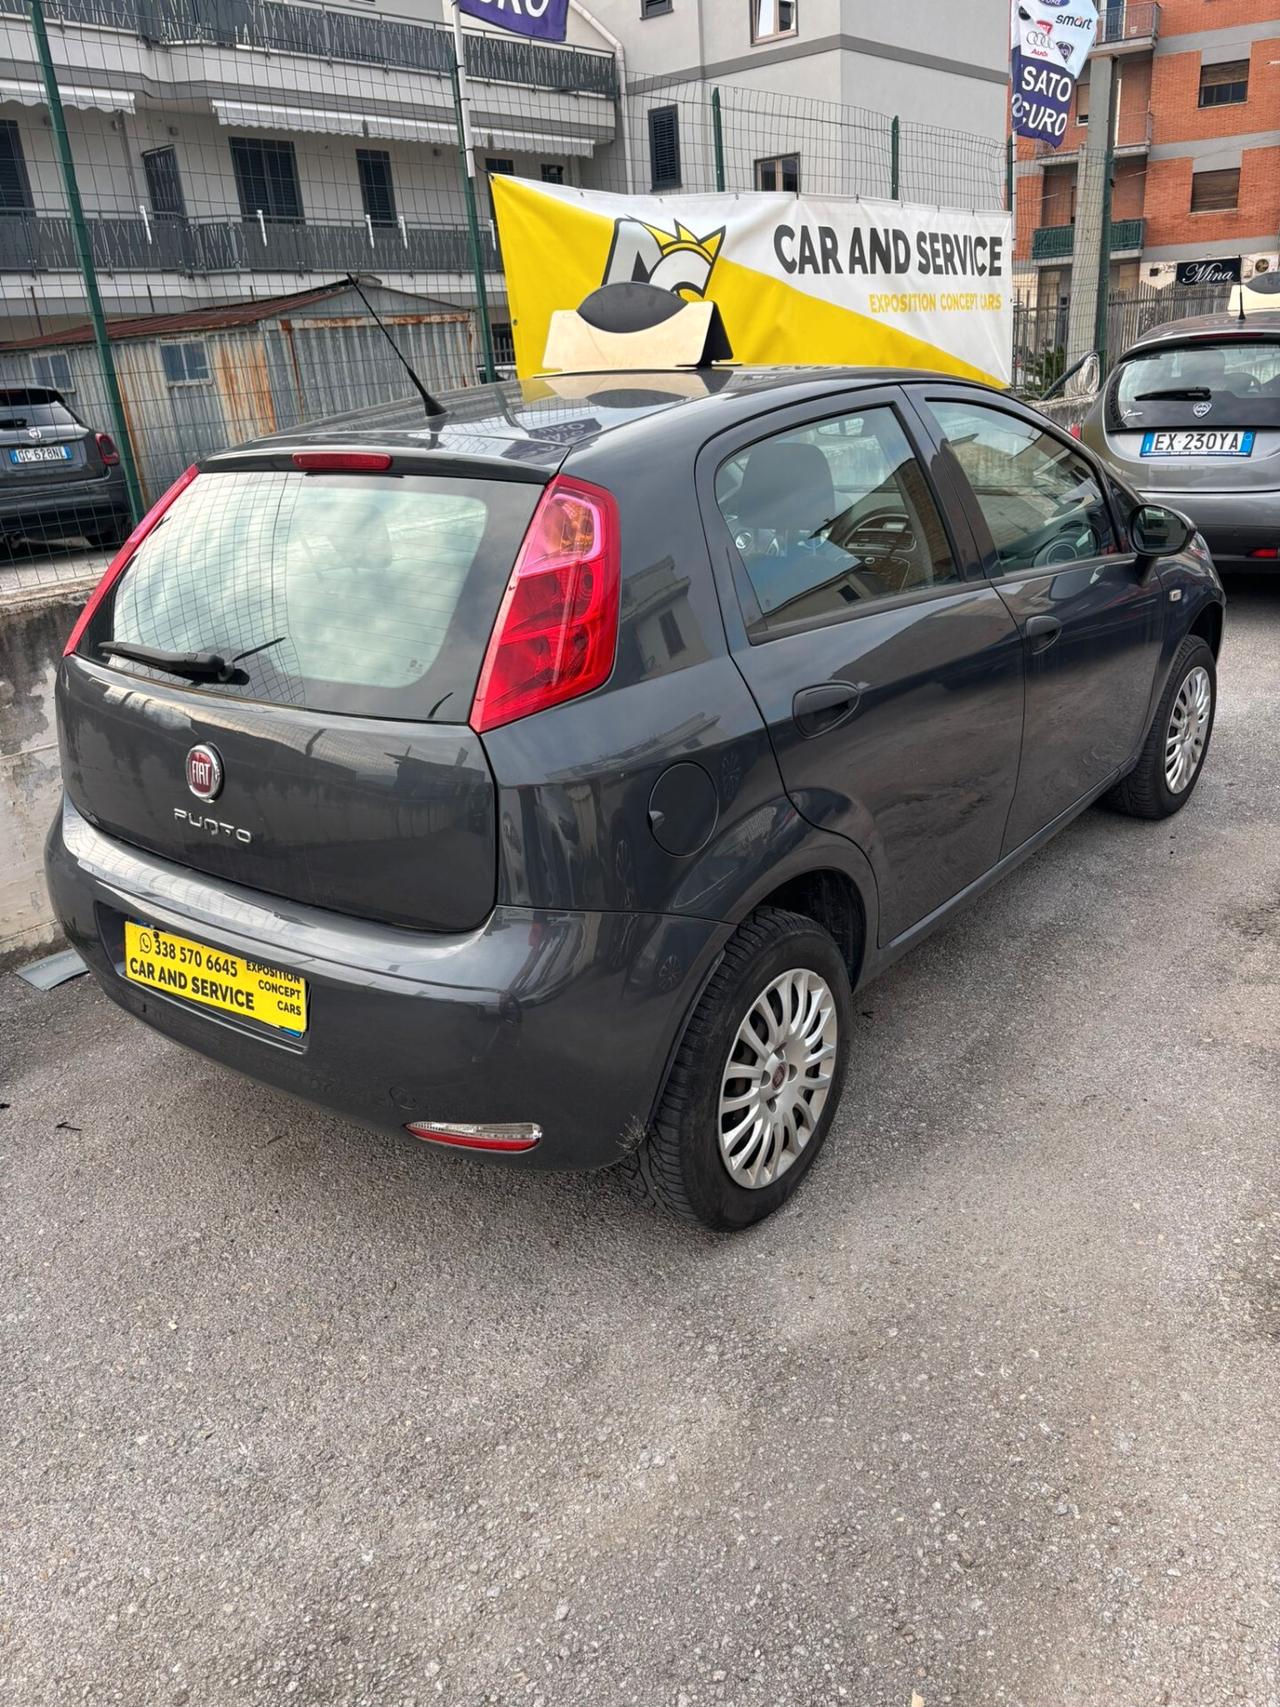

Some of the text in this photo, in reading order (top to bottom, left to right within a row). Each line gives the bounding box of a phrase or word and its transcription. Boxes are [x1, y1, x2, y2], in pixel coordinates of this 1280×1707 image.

[1055, 14, 1093, 30] smart
[773, 224, 844, 274] CAR
[849, 227, 911, 274] AND
[916, 230, 1003, 277] SERVICE
[1182, 262, 1234, 284] Mina
[868, 293, 936, 313] EXPOSITION
[940, 294, 978, 313] CONCEPT
[1154, 433, 1238, 450] EX 230YA
[191, 760, 211, 786] FIAT
[173, 807, 252, 844] PUNTO
[154, 939, 238, 977] 338 570 6645
[129, 957, 255, 1010] CAR AND SERVICE
[246, 960, 301, 985] EXPOSITION
[258, 979, 302, 1000] CONCEPT
[277, 1000, 302, 1016] CARS
